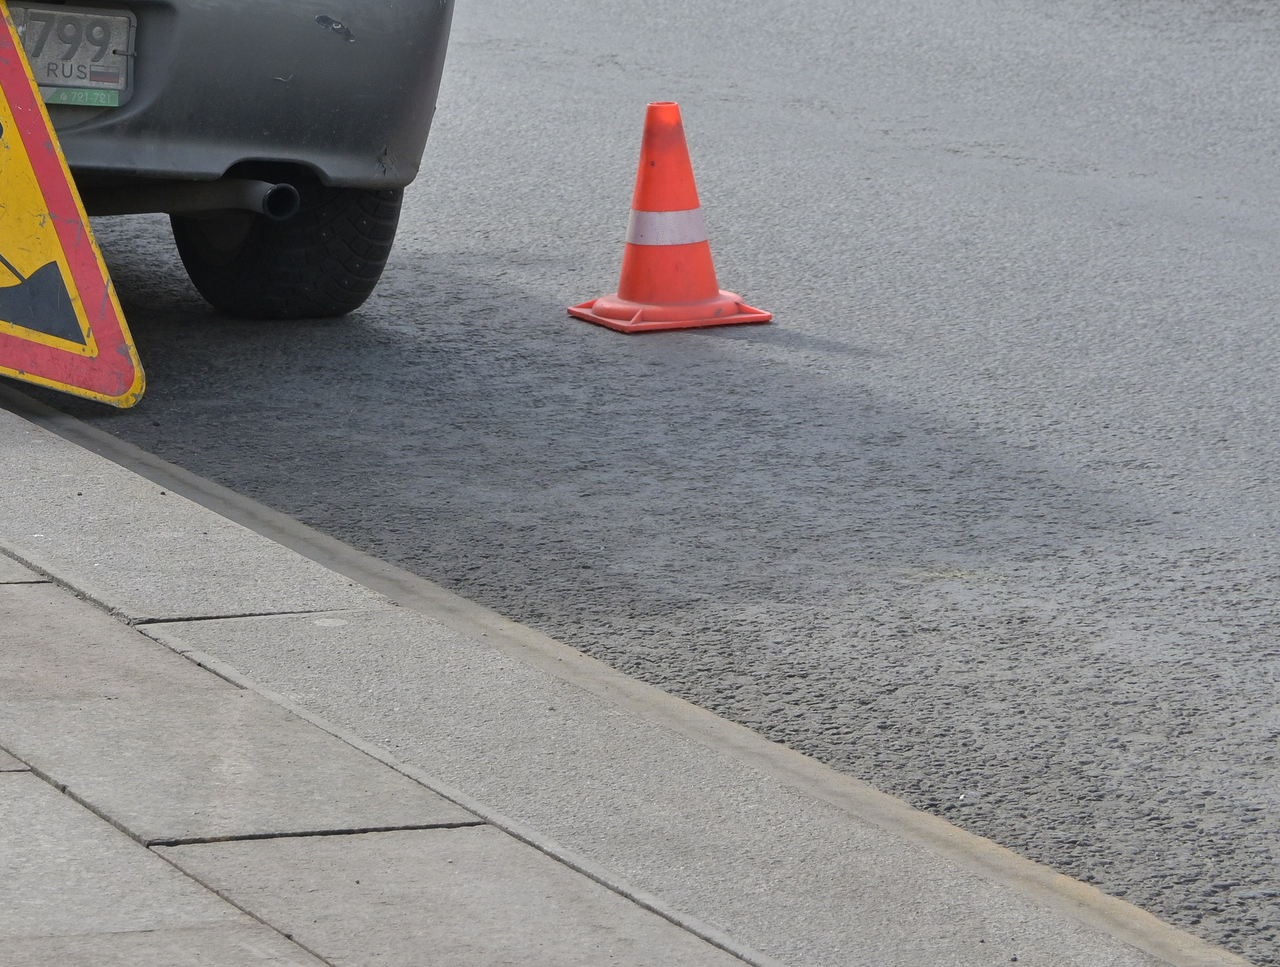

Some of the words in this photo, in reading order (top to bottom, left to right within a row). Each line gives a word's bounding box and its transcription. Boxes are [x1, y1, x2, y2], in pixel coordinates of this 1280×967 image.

[28, 12, 112, 63] 799
[46, 62, 88, 80] RUS
[70, 90, 112, 104] 721-721
